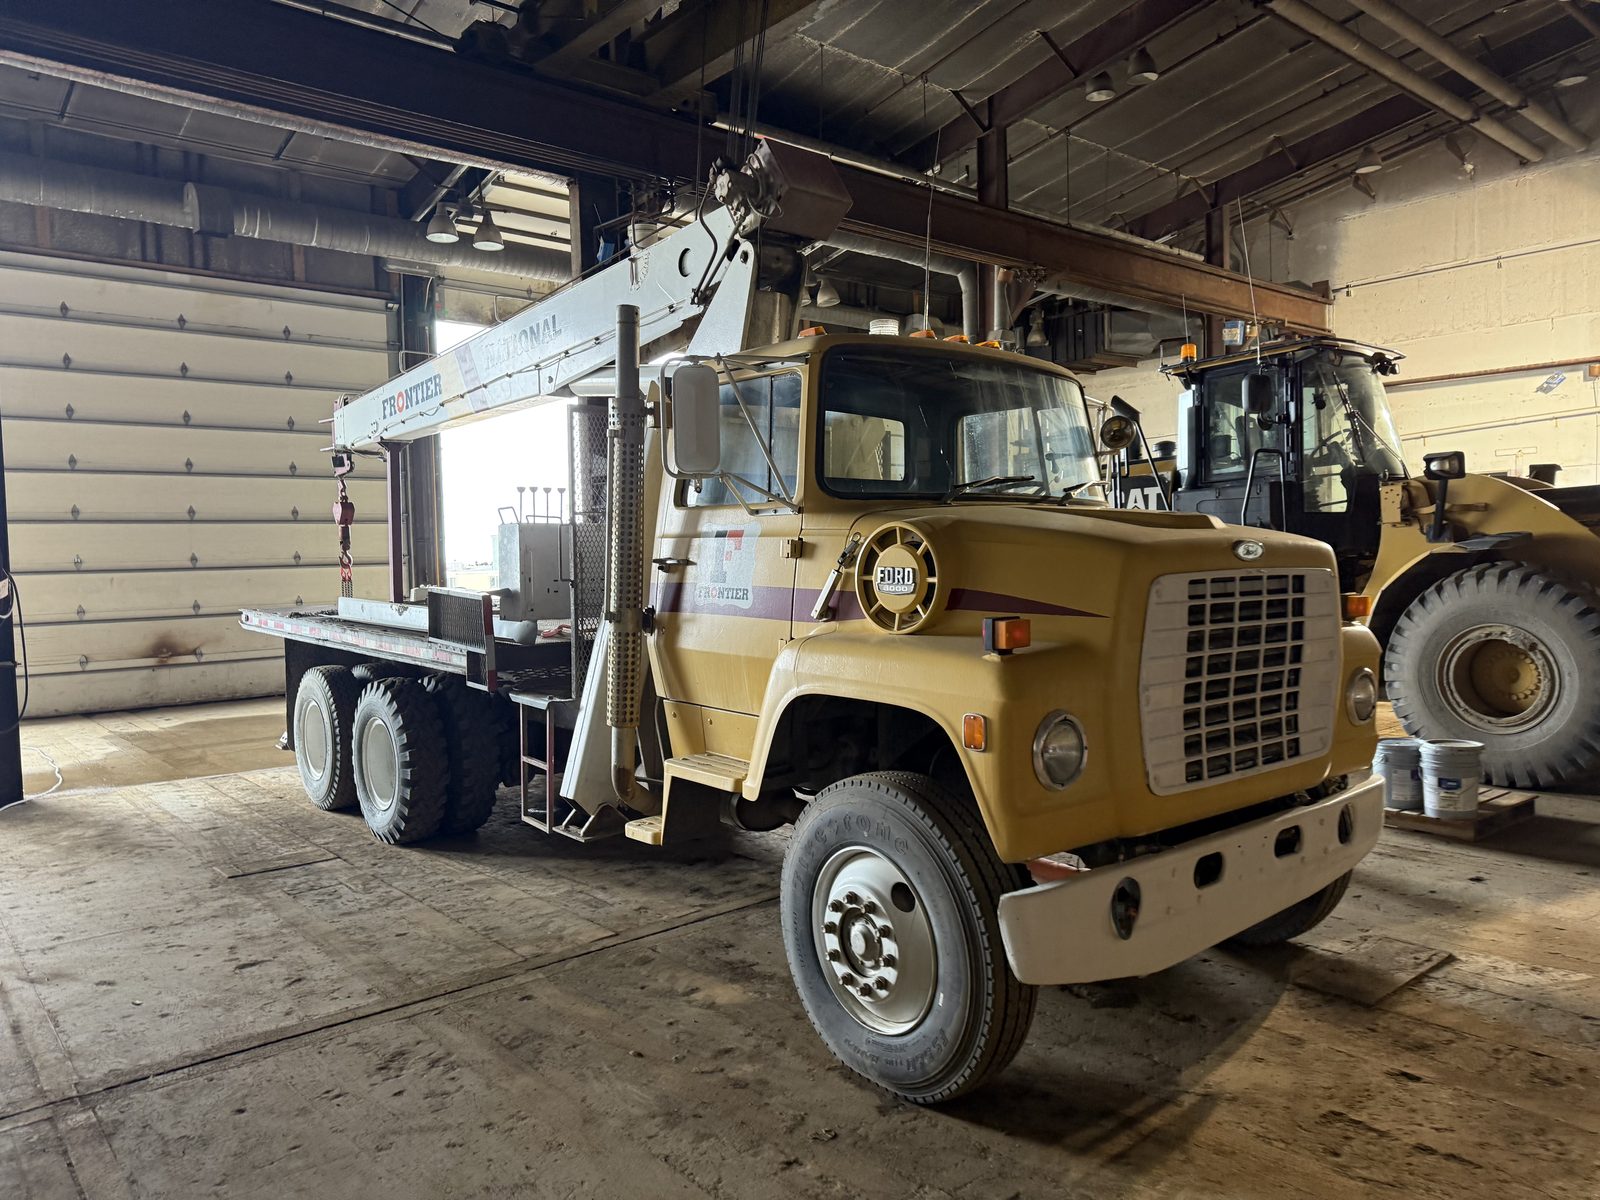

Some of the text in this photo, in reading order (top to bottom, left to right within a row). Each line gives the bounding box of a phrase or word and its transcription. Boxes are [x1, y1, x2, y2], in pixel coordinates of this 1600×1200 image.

[382, 373, 442, 420] FRONTIER
[877, 567, 914, 584] FORD
[697, 586, 749, 601] FRONTIER
